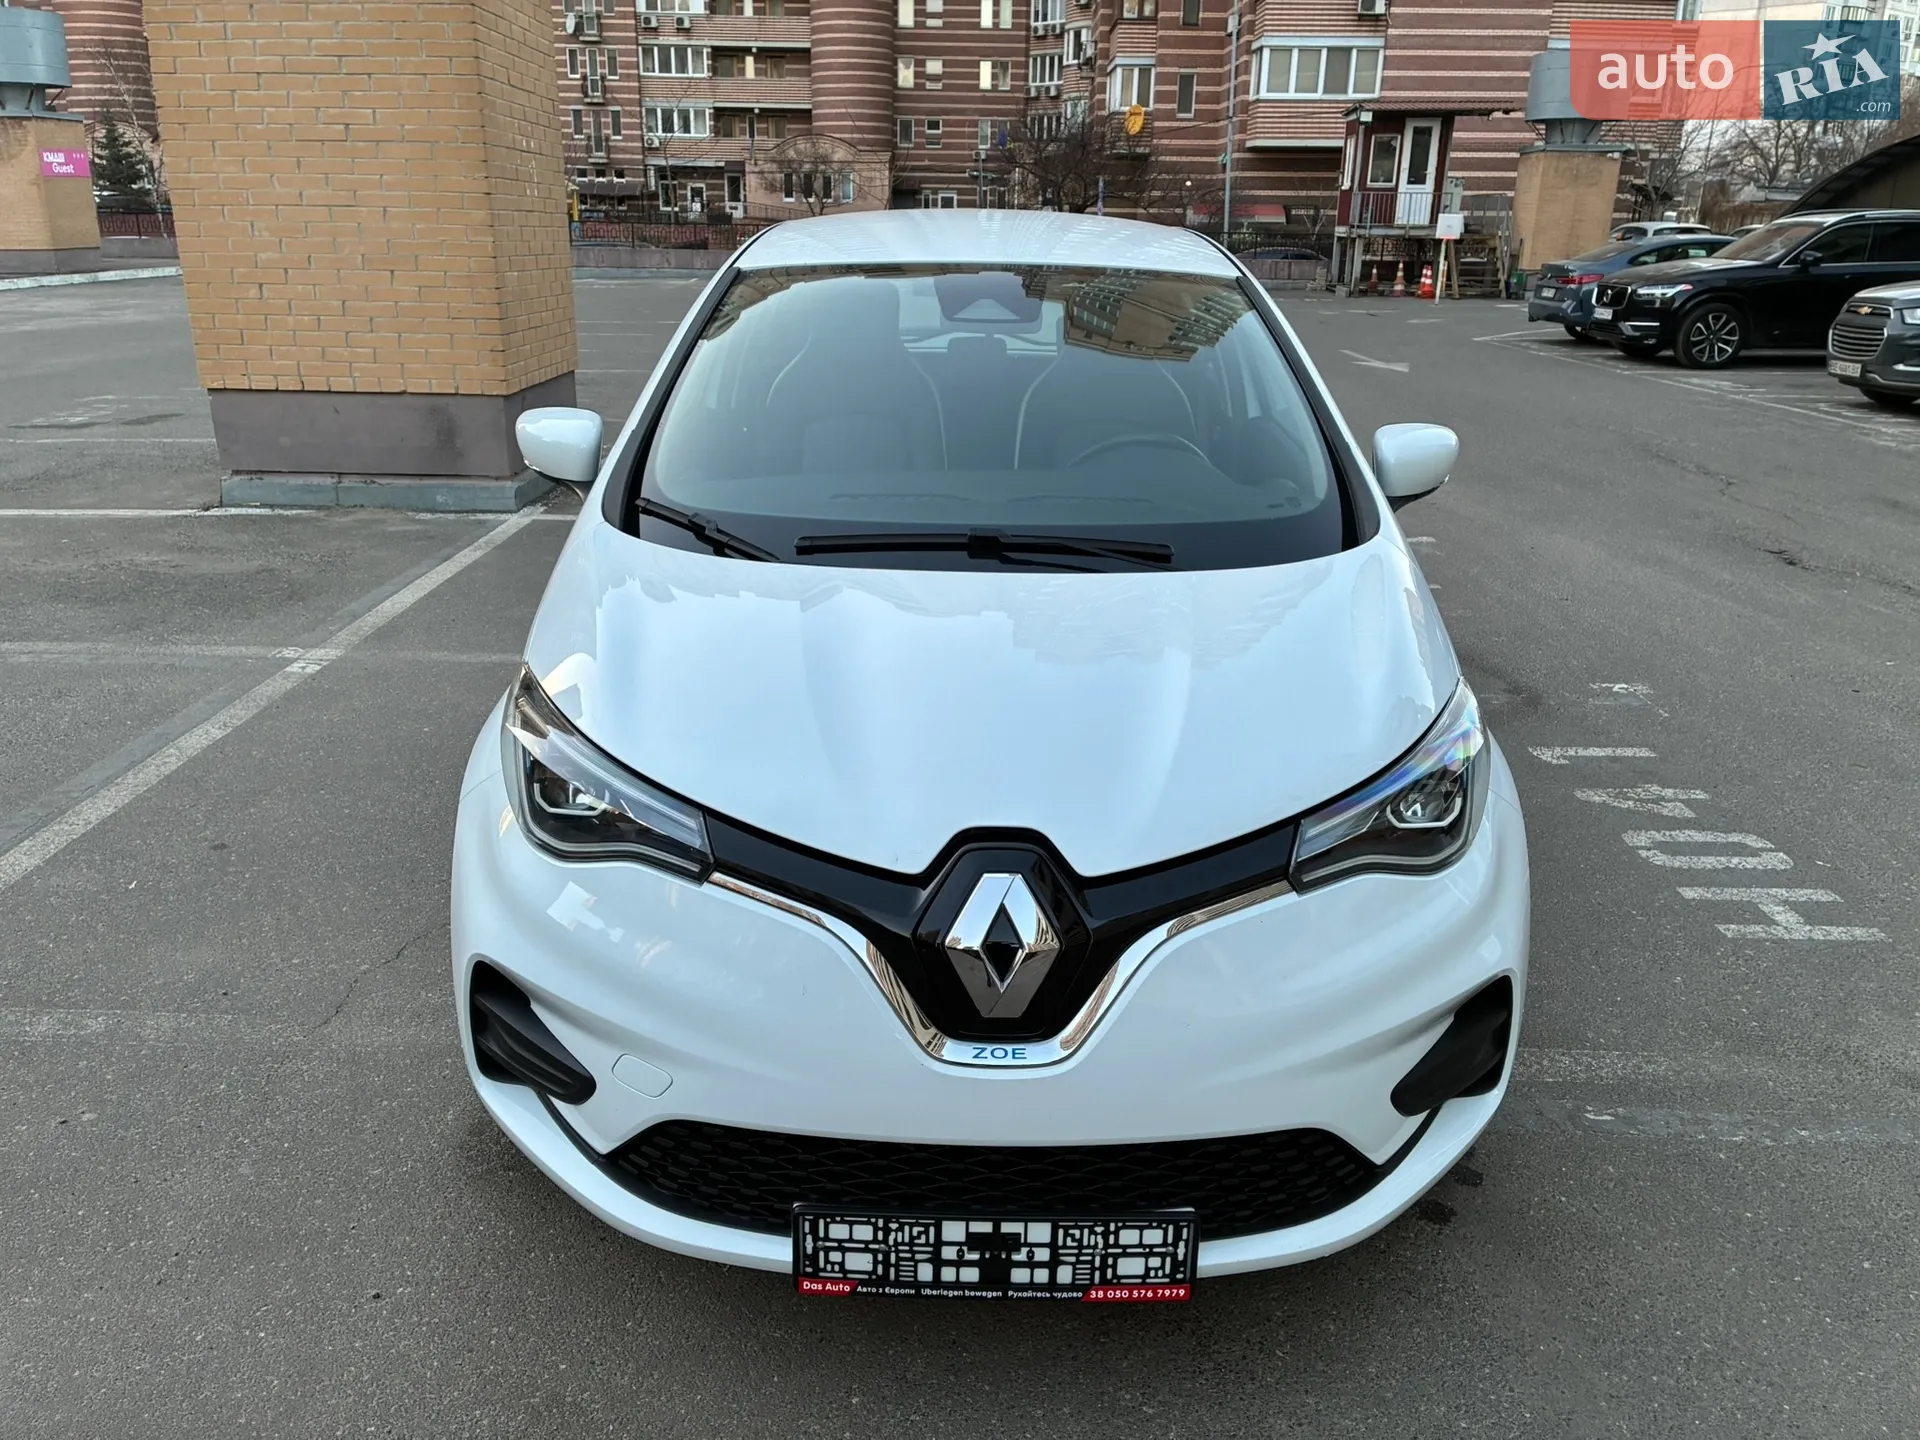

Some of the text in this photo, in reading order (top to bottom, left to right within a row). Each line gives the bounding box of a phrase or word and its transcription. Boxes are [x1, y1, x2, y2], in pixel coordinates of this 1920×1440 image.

[52, 162, 75, 174] Guest
[972, 1047, 1027, 1059] ZOE
[803, 1281, 851, 1292] Das Auto
[1053, 1291, 1083, 1299] чудово
[1090, 1288, 1186, 1299] 38 050 576 7979
